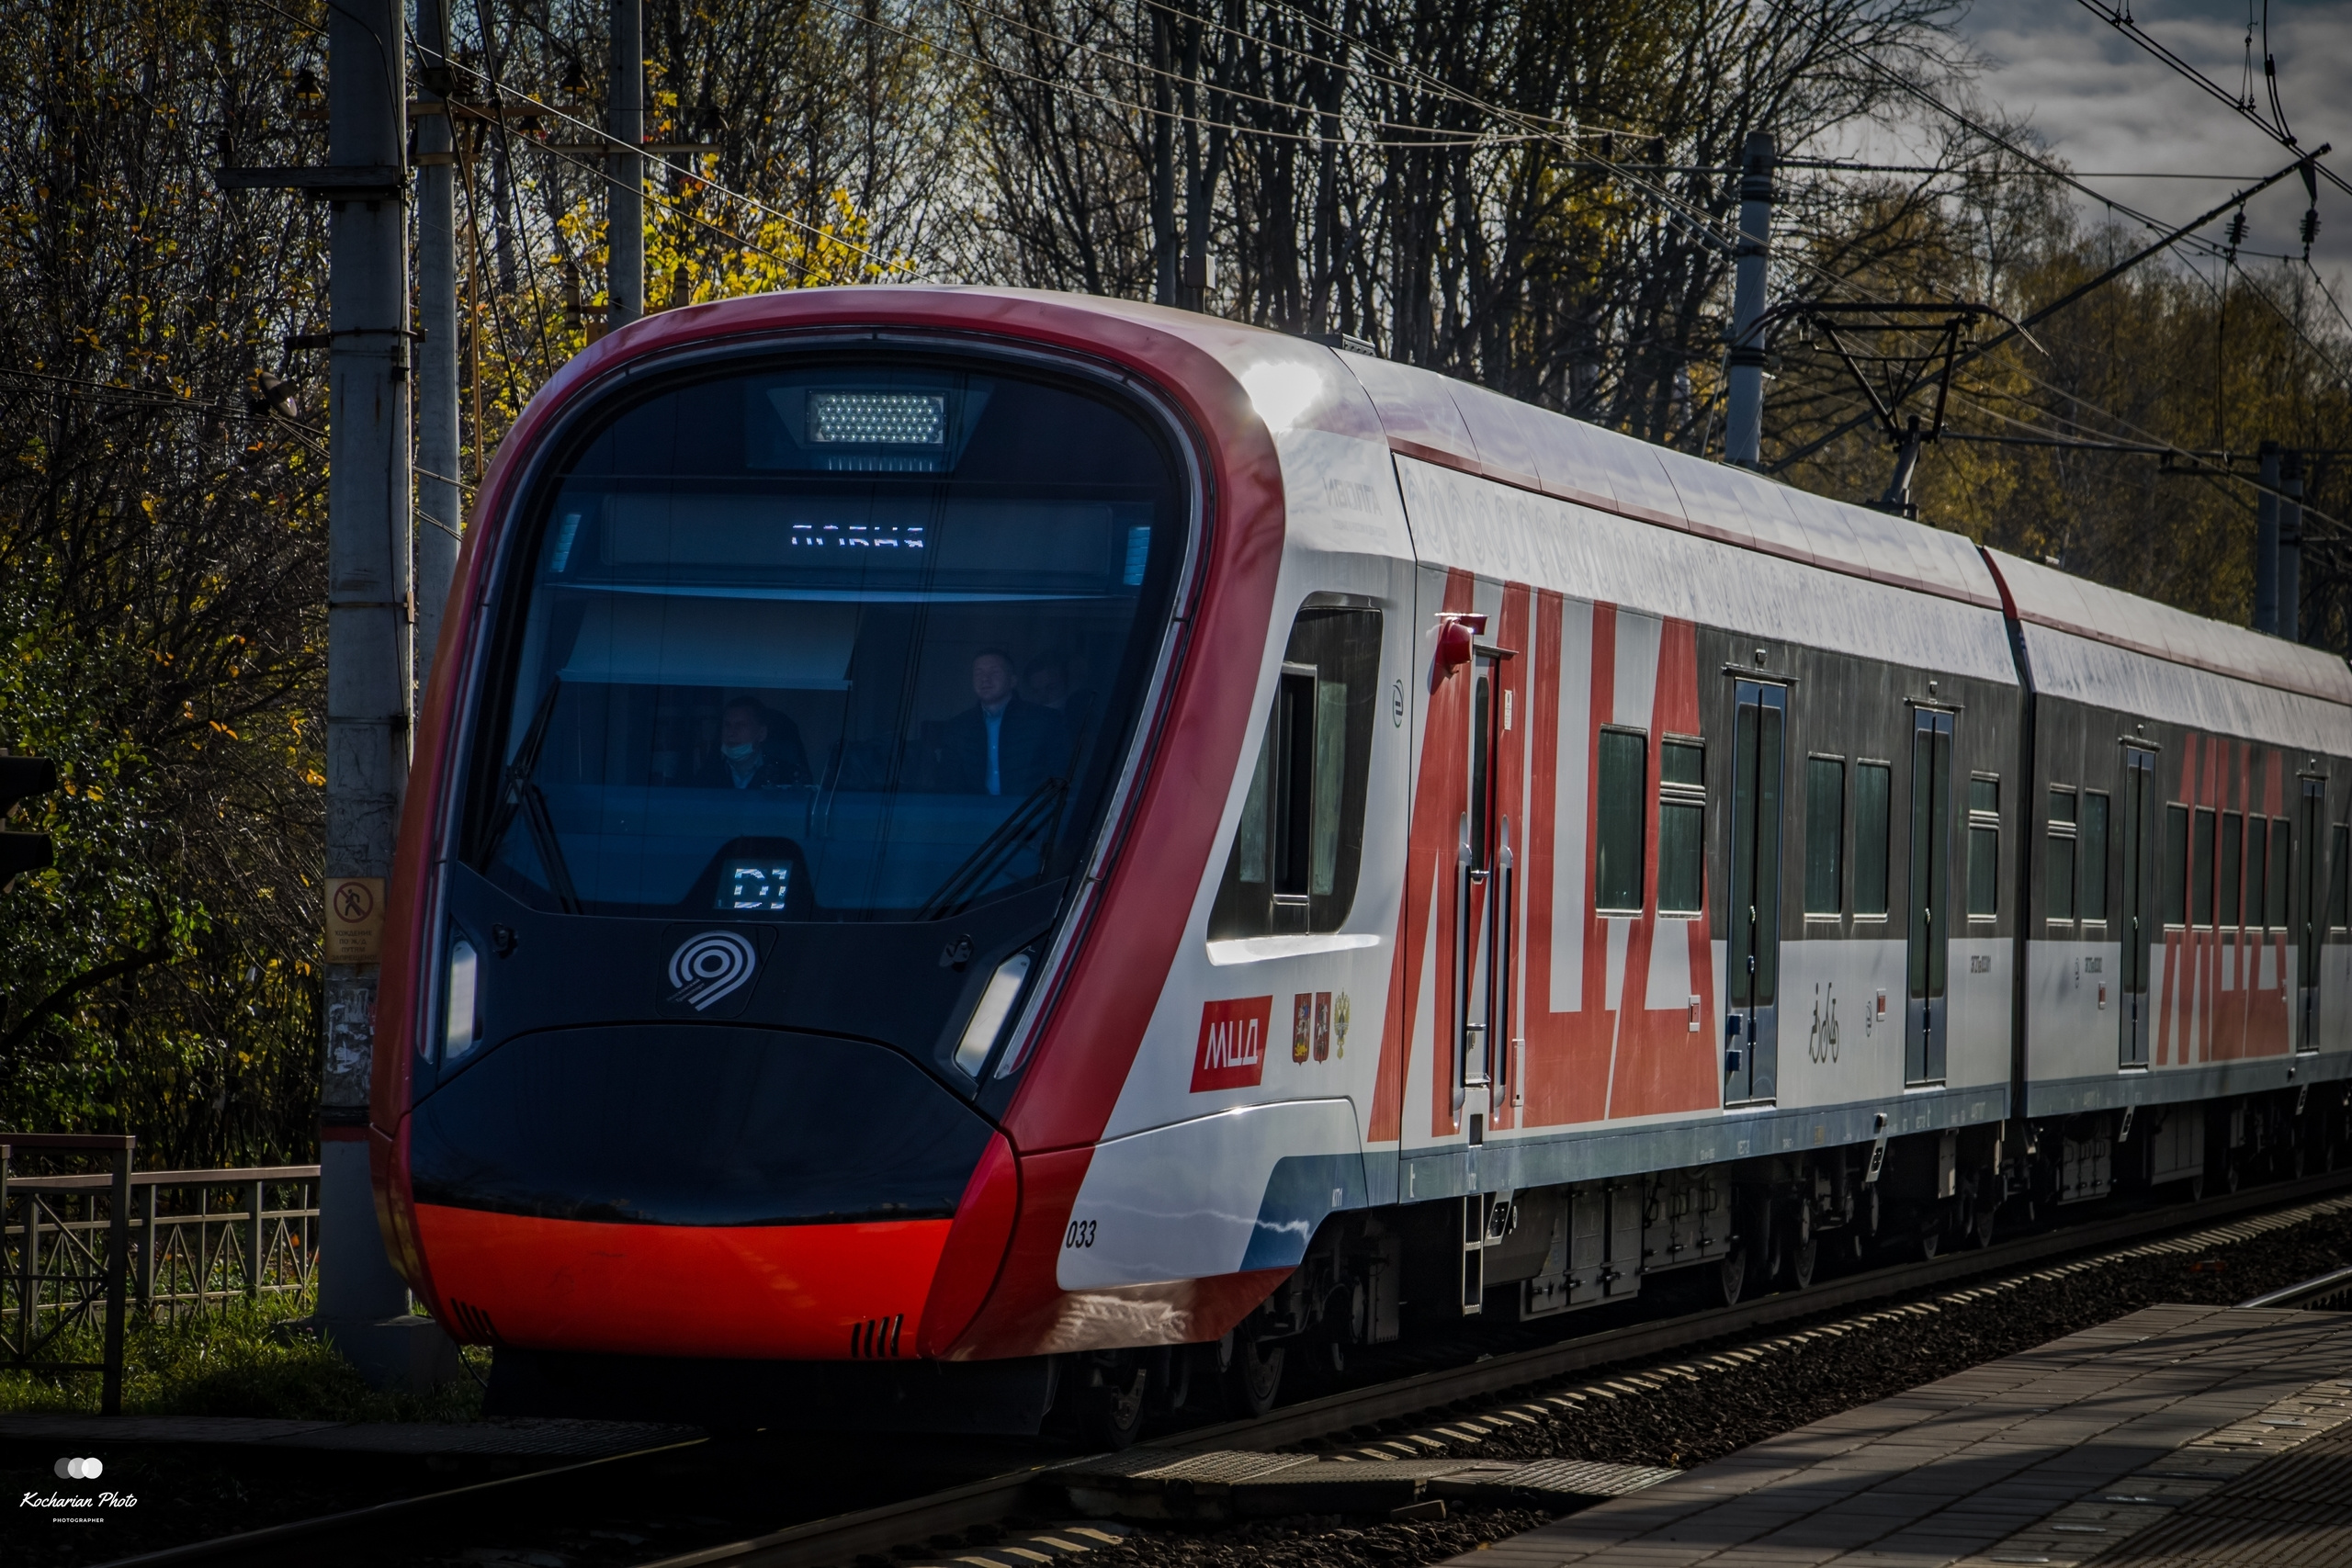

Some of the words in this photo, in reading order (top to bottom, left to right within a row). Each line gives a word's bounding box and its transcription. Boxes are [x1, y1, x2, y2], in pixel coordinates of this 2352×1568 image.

[733, 867, 787, 909] D1
[334, 929, 373, 937] ХОЖДЕНИЕ
[1204, 1018, 1260, 1070] МЦД
[1065, 1219, 1098, 1249] 033
